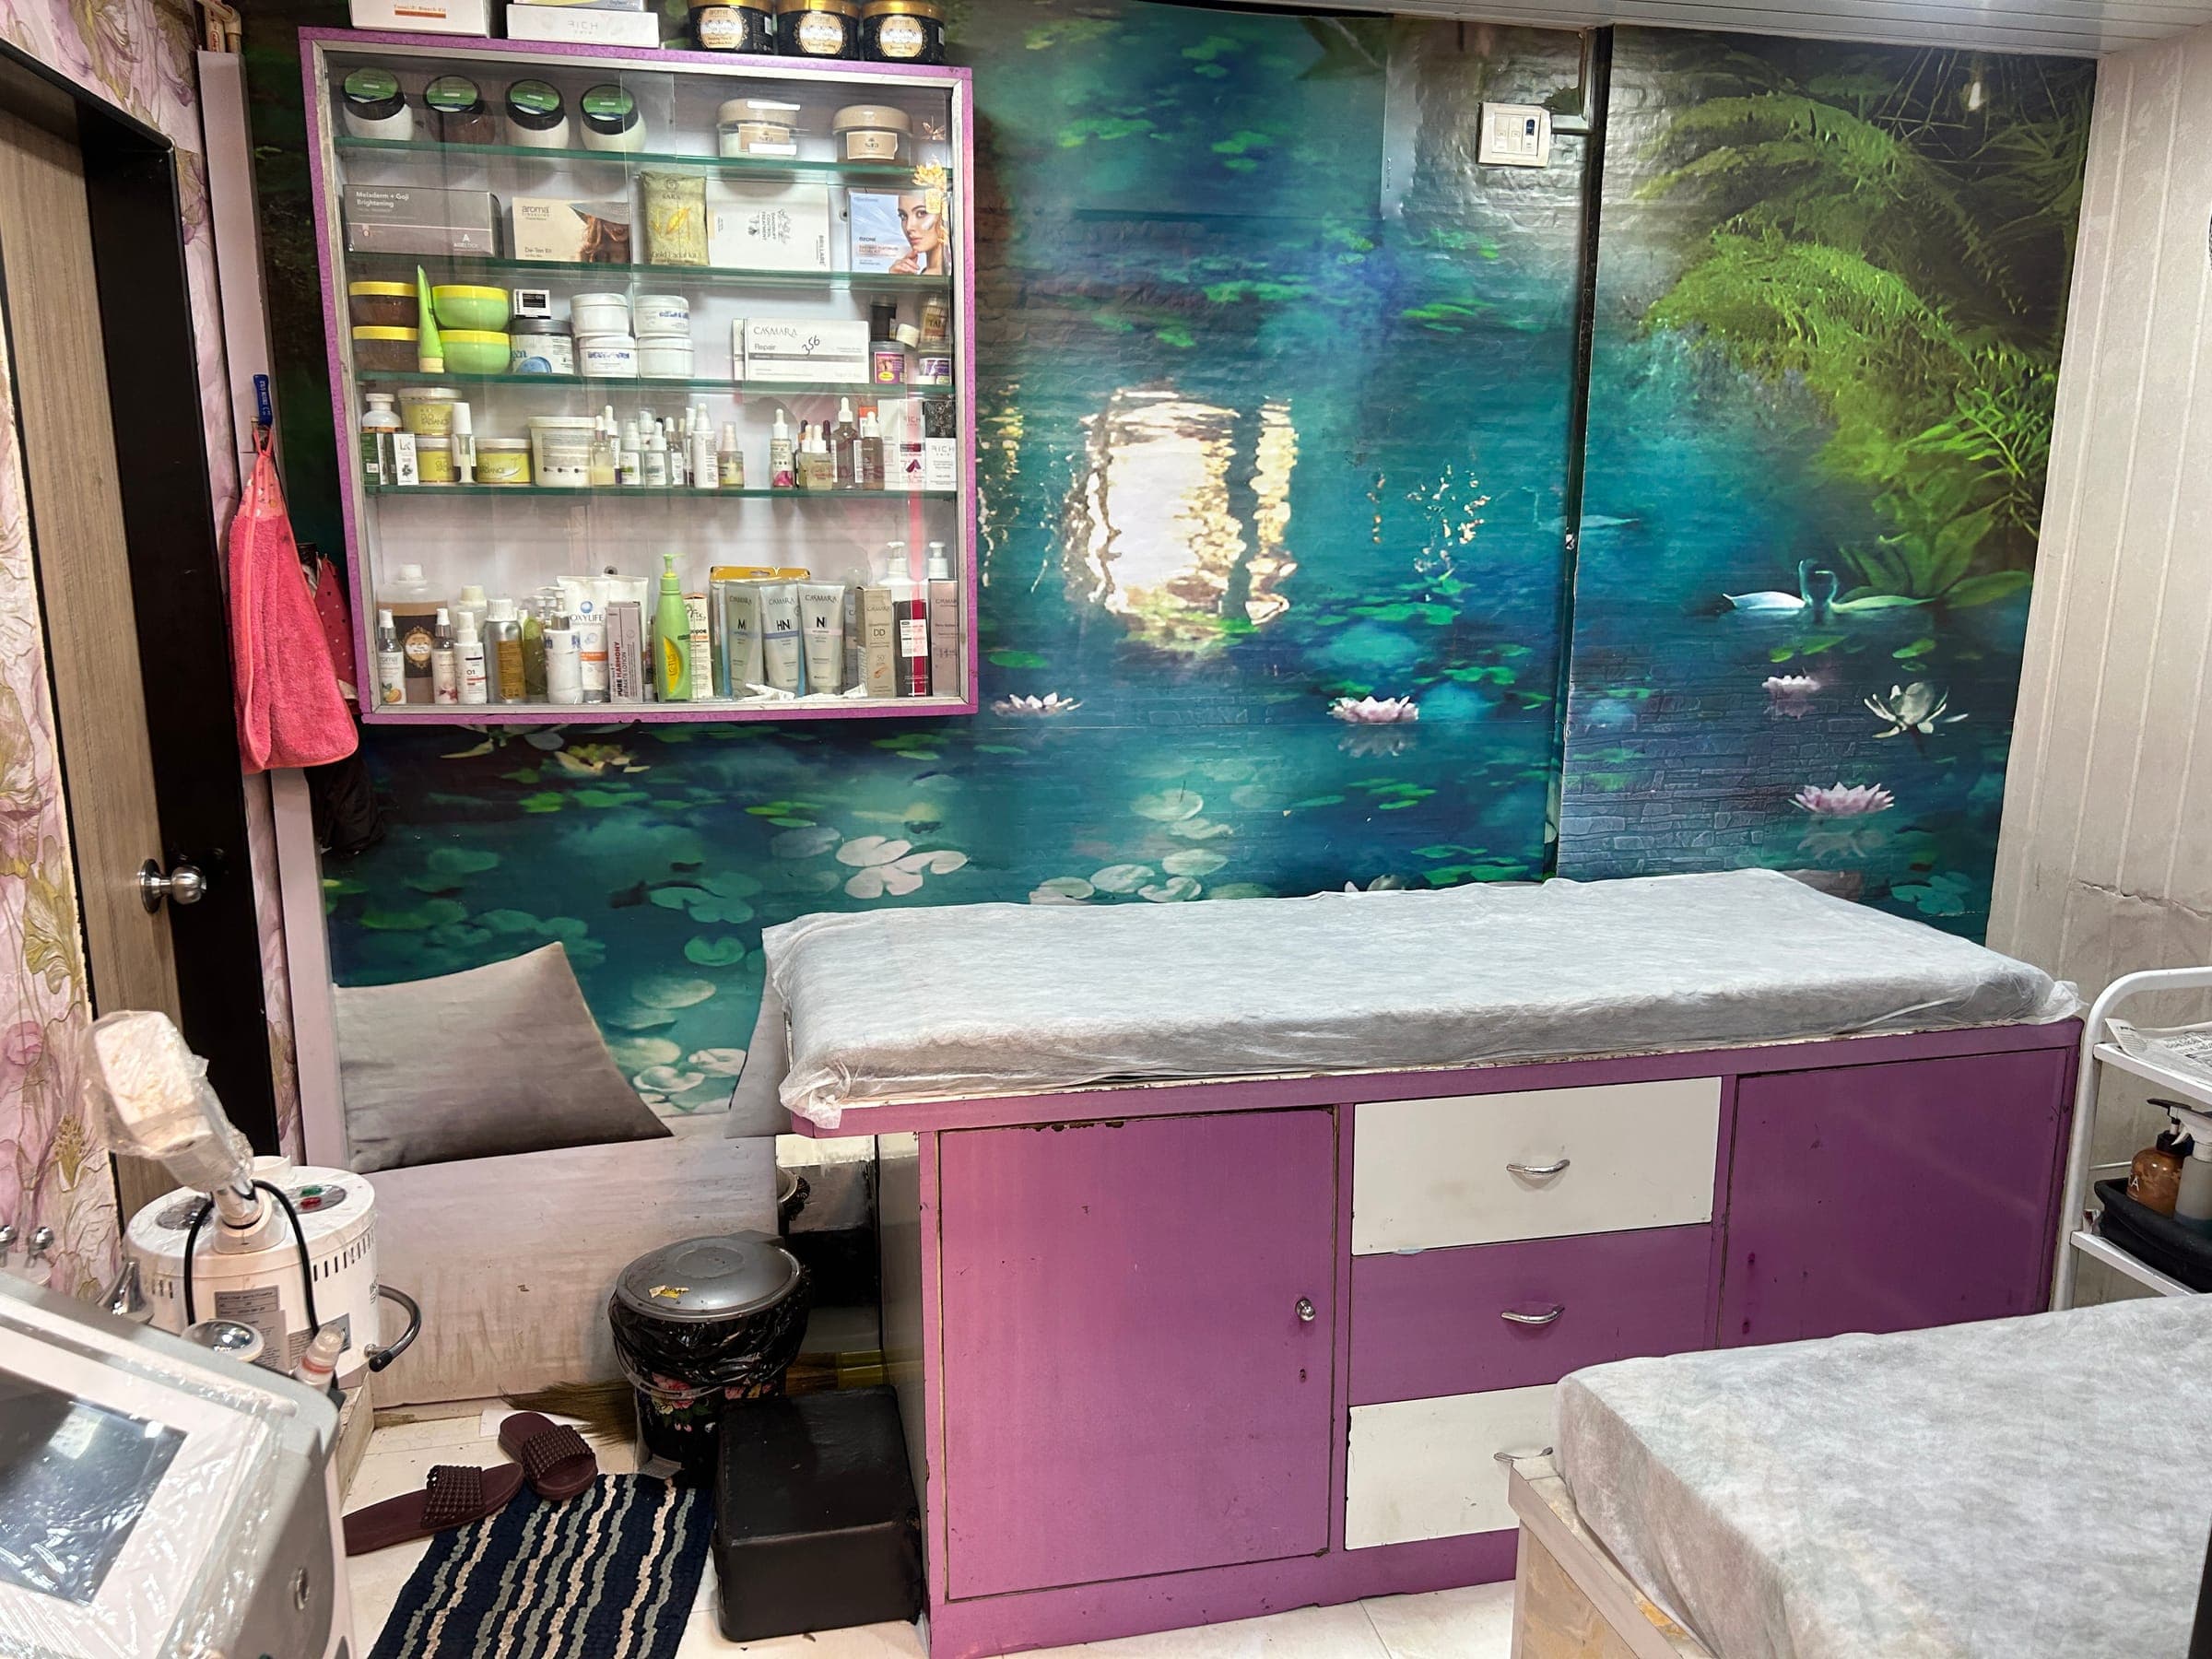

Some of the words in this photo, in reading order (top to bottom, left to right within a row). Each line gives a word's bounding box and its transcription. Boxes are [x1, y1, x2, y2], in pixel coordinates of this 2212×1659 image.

[395, 193, 410, 201] Goji
[357, 199, 394, 208] Brightening
[522, 206, 550, 214] aroma
[753, 325, 798, 338] CASMARA
[754, 343, 777, 351] Repair
[801, 335, 821, 357] 356
[805, 594, 838, 604] CASMARA
[570, 614, 604, 622] OXYLIFE
[816, 617, 826, 628] N
[737, 618, 746, 630] M
[776, 618, 791, 631] HN
[873, 629, 886, 637] DD
[614, 641, 622, 678] HARMONY
